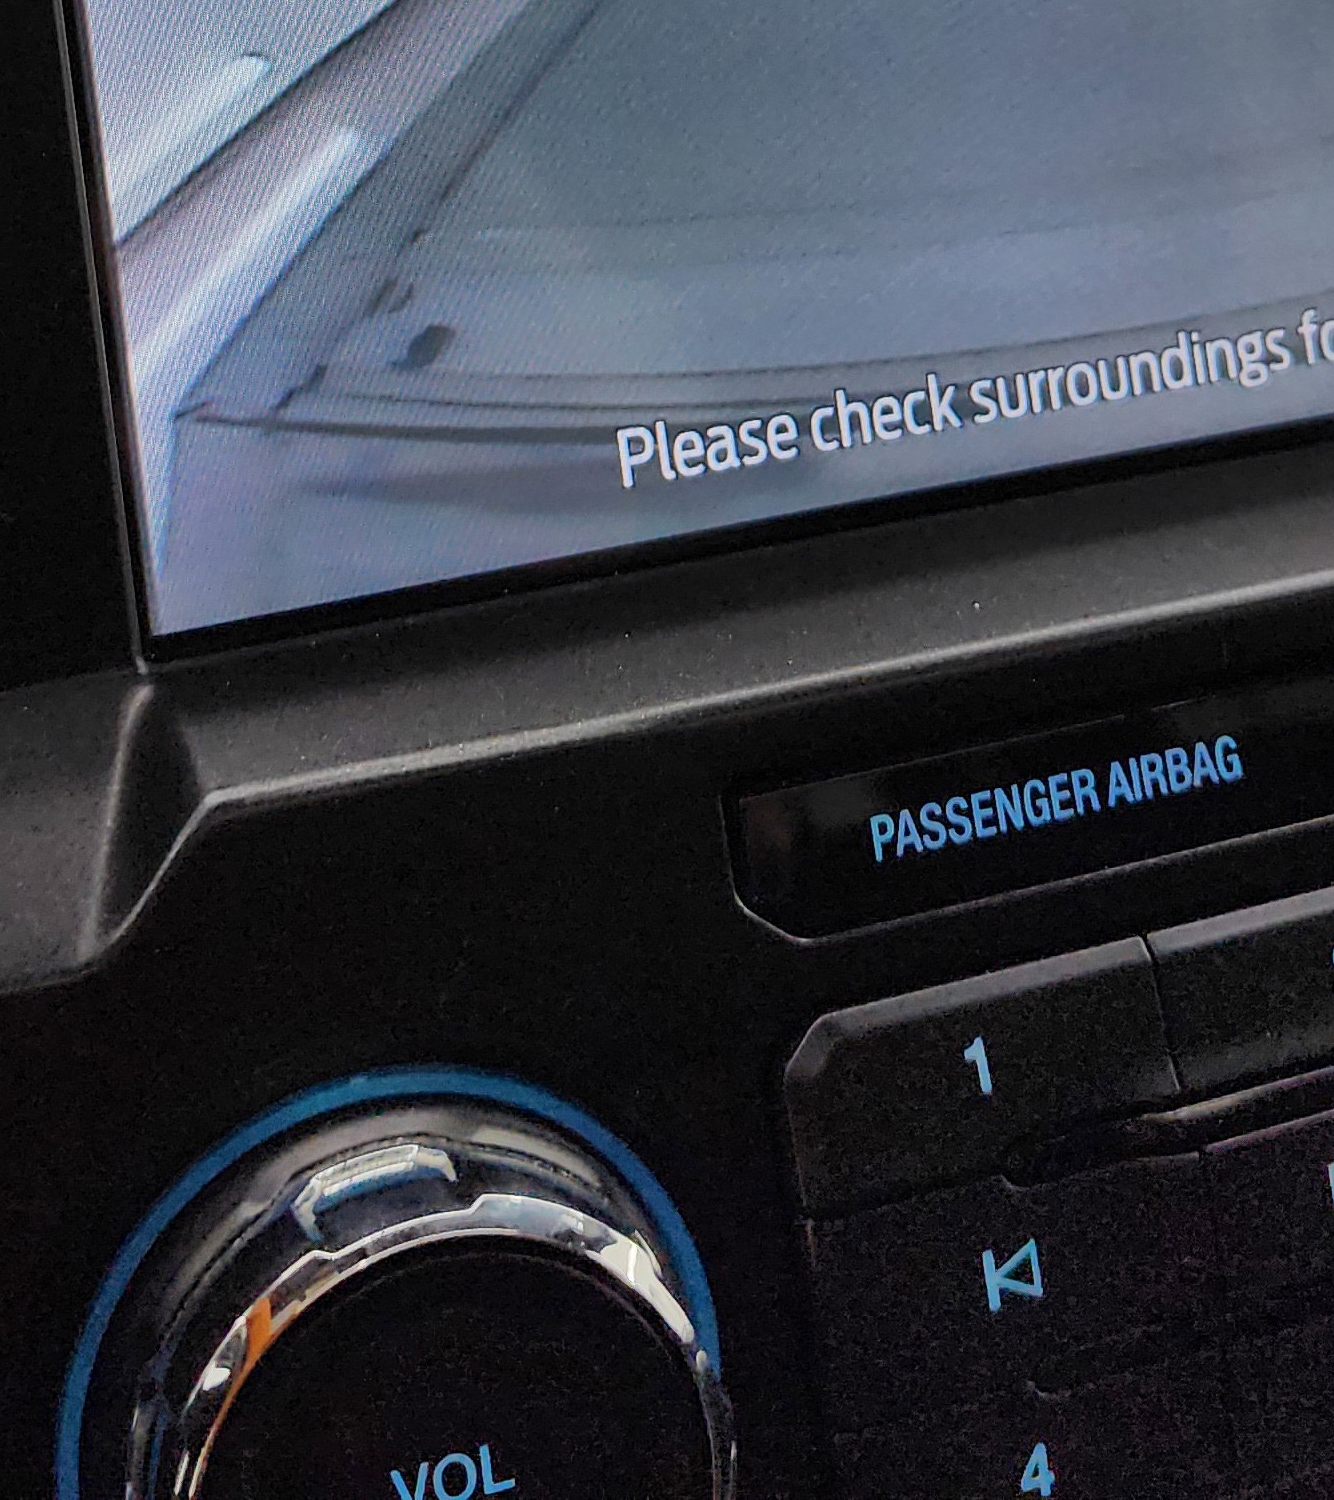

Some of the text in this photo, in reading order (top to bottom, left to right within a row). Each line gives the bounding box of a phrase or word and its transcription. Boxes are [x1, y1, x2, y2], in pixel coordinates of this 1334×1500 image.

[616, 414, 799, 488] Please
[810, 373, 961, 452] check
[969, 326, 1289, 425] surroundings
[869, 735, 1244, 862] PASSENGER AIRBAG
[963, 1036, 993, 1095] 1
[389, 1444, 516, 1500] VOL
[1020, 1442, 1056, 1497] 4
